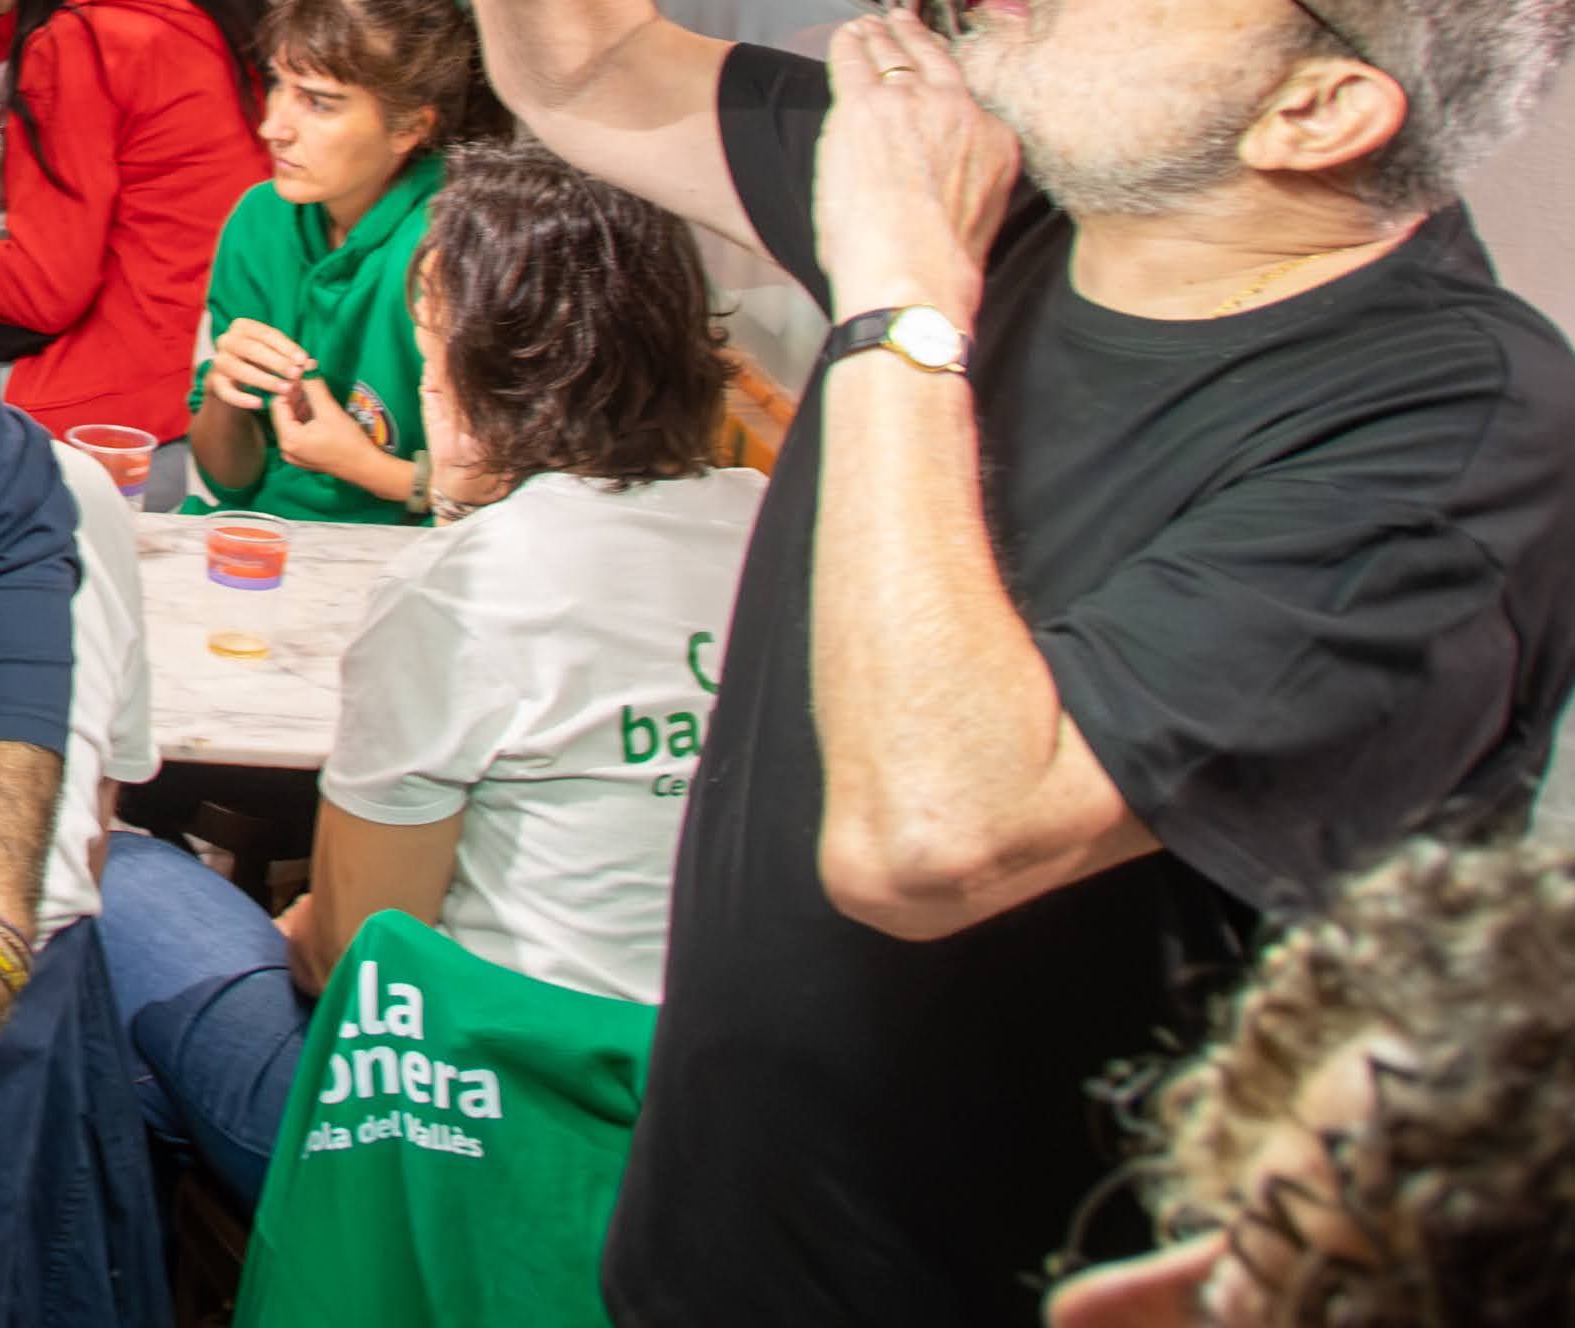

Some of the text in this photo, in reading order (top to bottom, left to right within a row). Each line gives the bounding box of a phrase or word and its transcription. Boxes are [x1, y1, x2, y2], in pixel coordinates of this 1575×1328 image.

[686, 631, 720, 694] C
[620, 704, 700, 764] ba
[651, 773, 687, 797] Ce
[338, 960, 424, 1040] la
[318, 1045, 503, 1119] onera
[301, 1122, 353, 1159] ola
[356, 1110, 402, 1144] del
